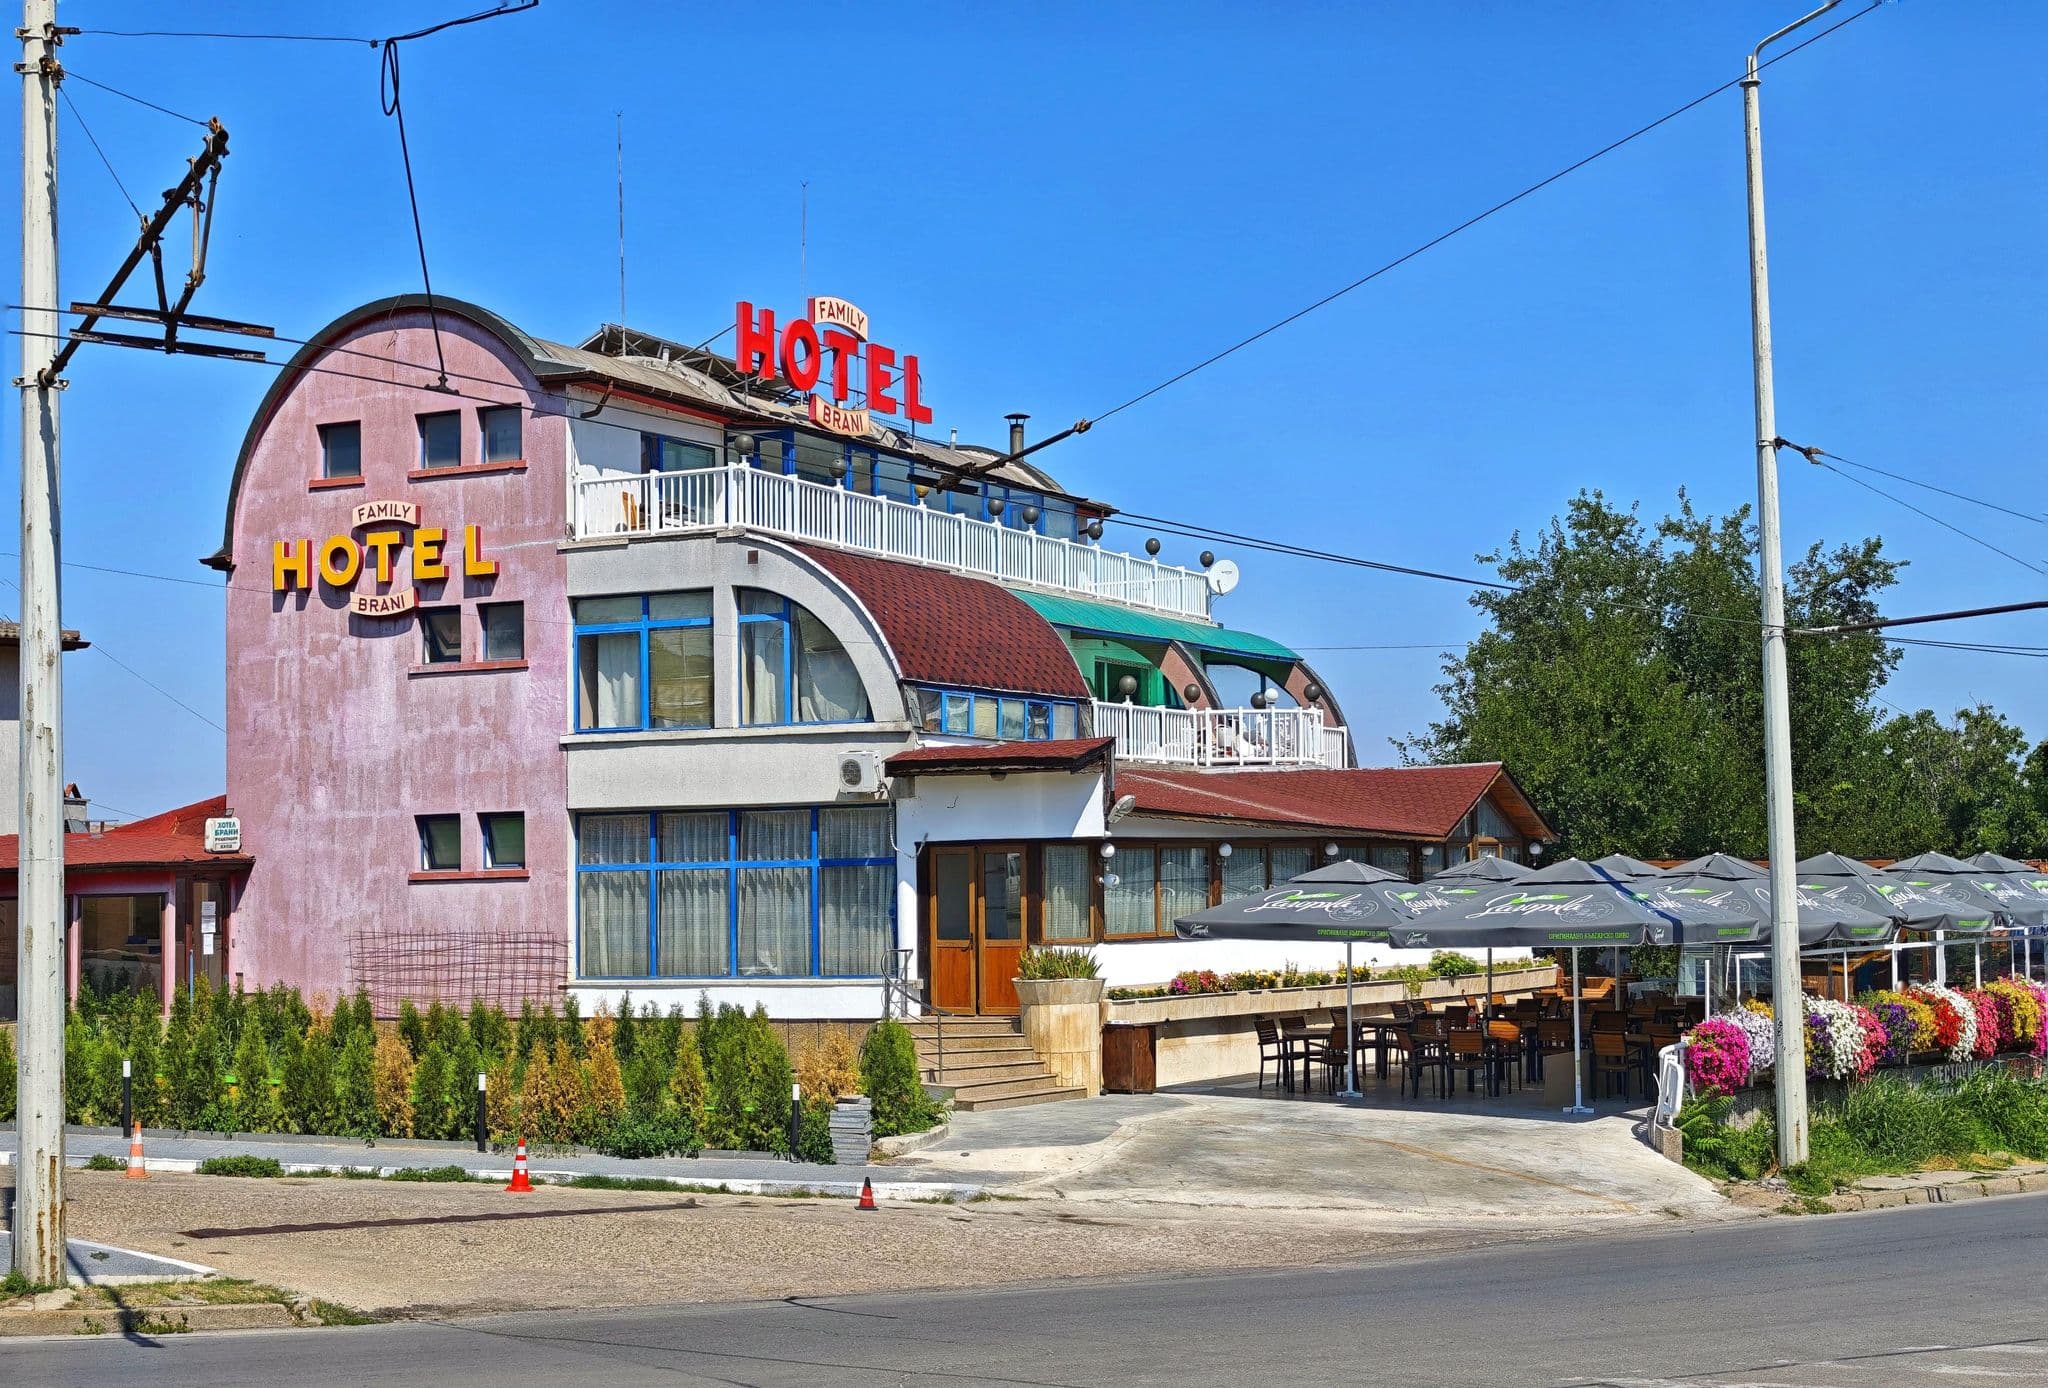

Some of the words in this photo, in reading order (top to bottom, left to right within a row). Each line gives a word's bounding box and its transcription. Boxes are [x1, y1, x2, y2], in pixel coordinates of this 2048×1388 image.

[819, 301, 864, 331] FAMILY
[736, 301, 932, 424] HOTEL
[823, 407, 863, 433] BRANI
[358, 503, 411, 521] FAMILY
[273, 524, 499, 591] HOTEL
[358, 594, 405, 612] BRANI
